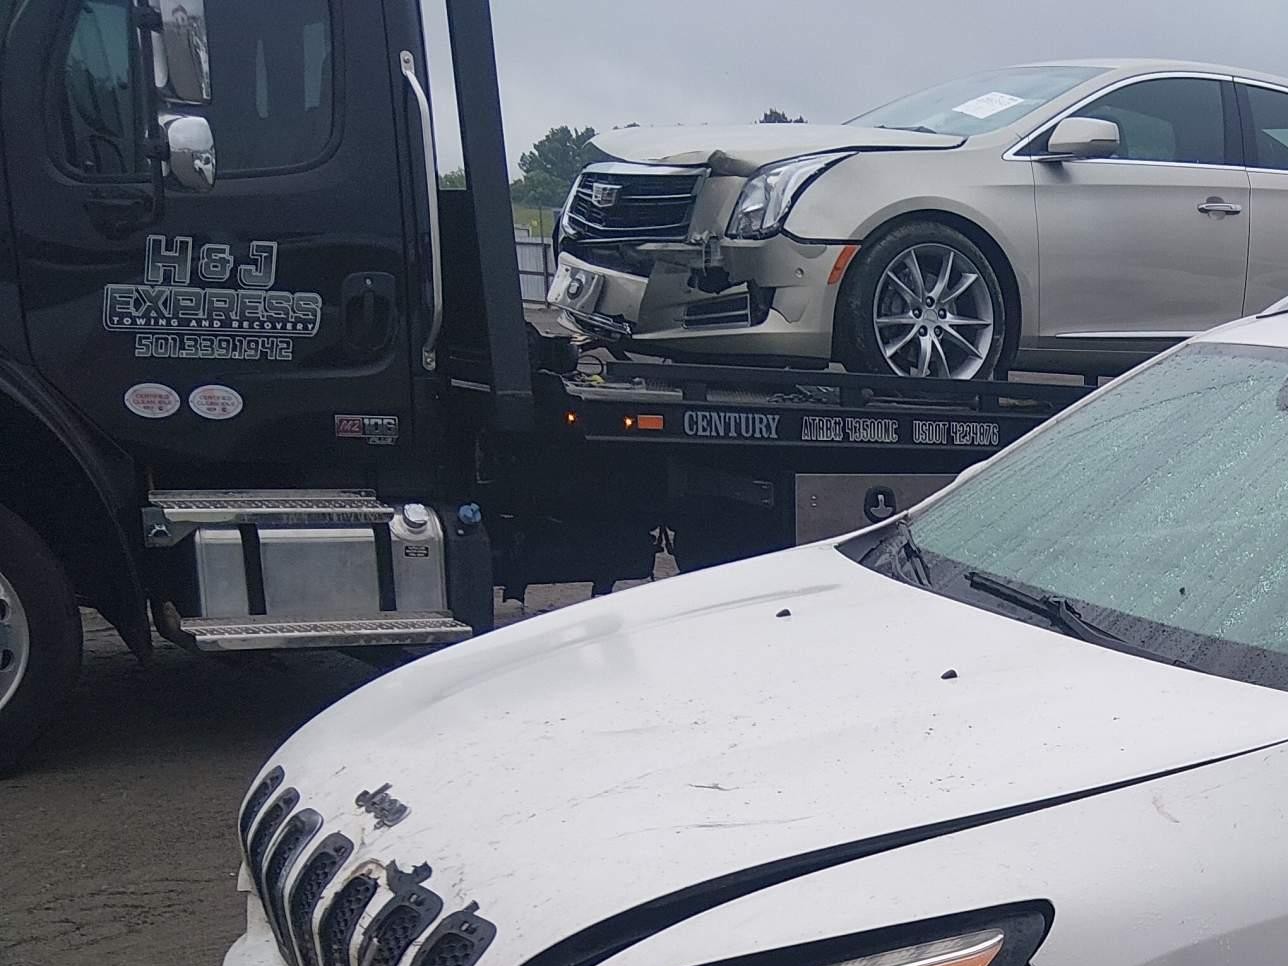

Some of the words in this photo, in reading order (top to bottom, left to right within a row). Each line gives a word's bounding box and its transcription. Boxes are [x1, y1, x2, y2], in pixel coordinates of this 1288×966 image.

[144, 235, 193, 286] H
[198, 243, 234, 282] &
[237, 241, 278, 289] J
[104, 284, 323, 322] EXPRESS
[112, 316, 179, 327] TOWING
[190, 319, 221, 328] AND
[231, 321, 315, 331] RECOVERY
[135, 334, 293, 360] 501.339.1942
[684, 411, 780, 439] CENTURY
[801, 416, 843, 441] ATRB#
[845, 418, 899, 443] 43500NC
[913, 420, 949, 444] USDOT
[950, 422, 1000, 446] 4234876
